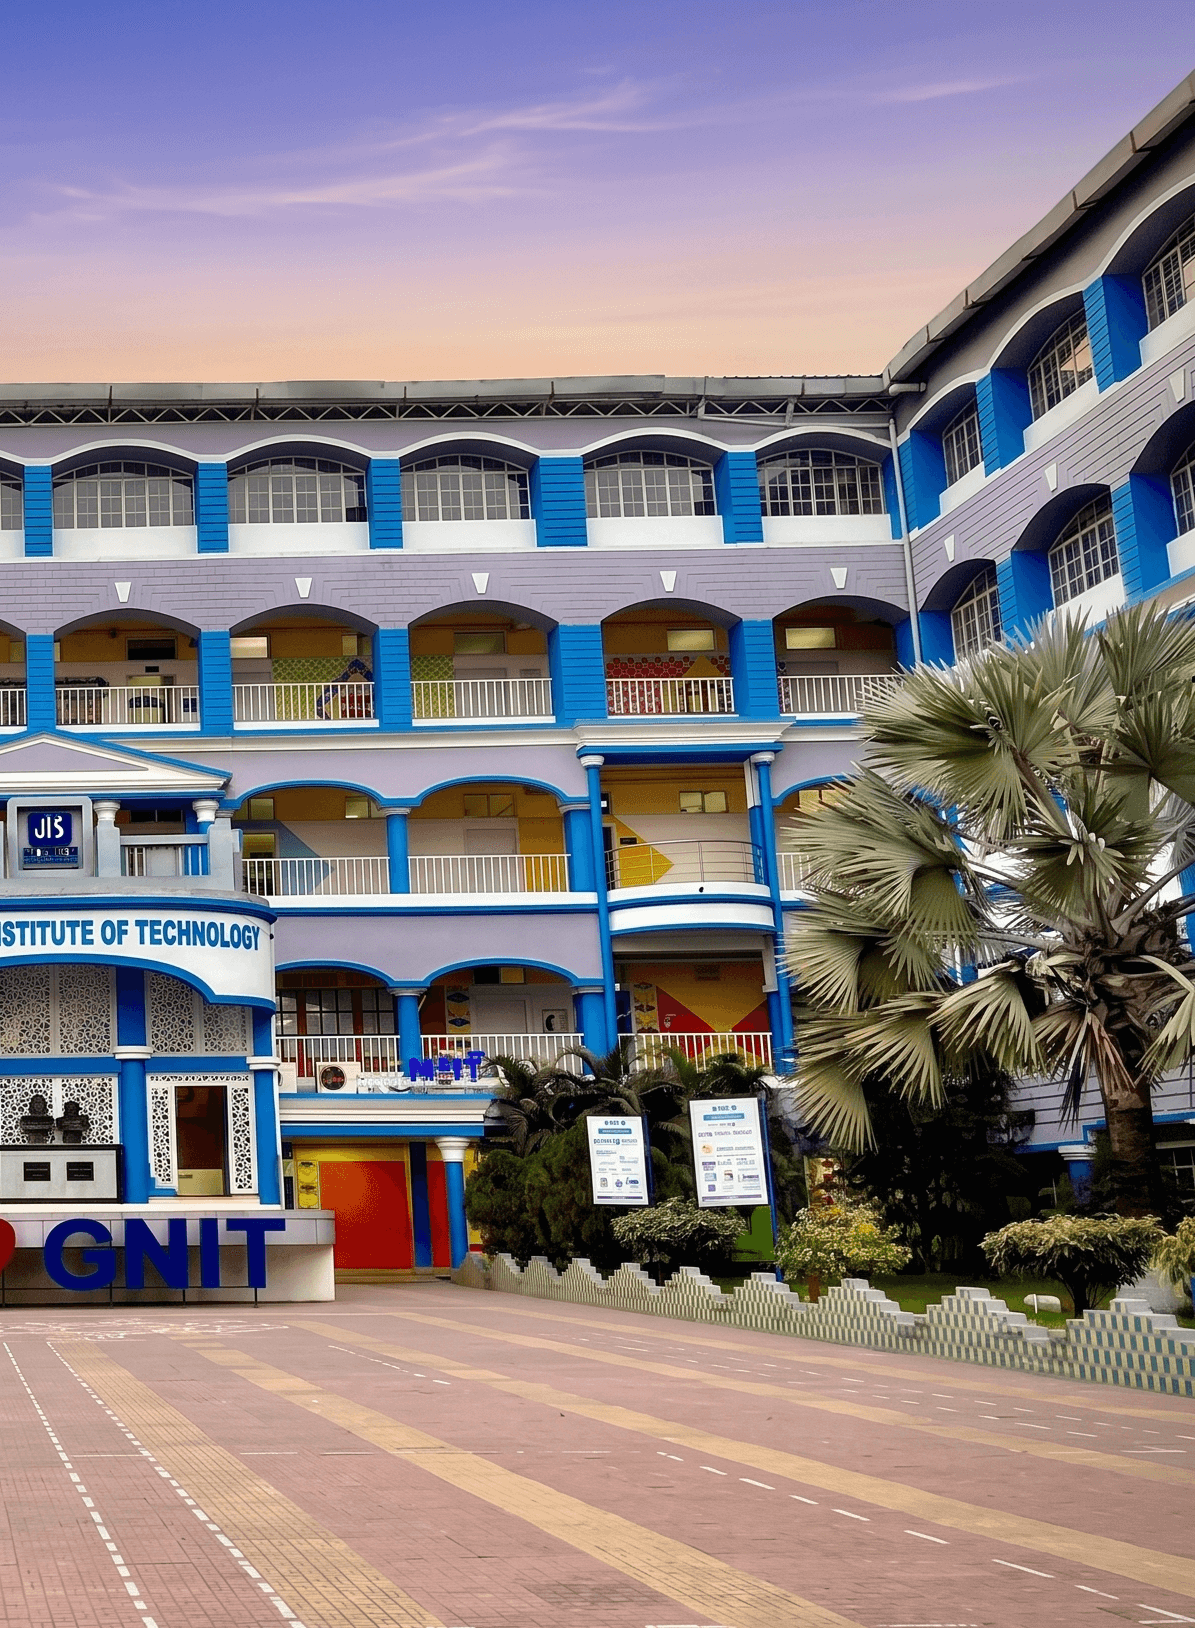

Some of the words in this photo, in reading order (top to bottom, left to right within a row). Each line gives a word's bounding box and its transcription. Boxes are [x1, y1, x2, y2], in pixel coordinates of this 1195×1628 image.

[34, 815, 65, 839] JIS
[100, 920, 129, 946] OF
[135, 919, 260, 950] TECHNOLOGY
[44, 1218, 286, 1291] GNIT
